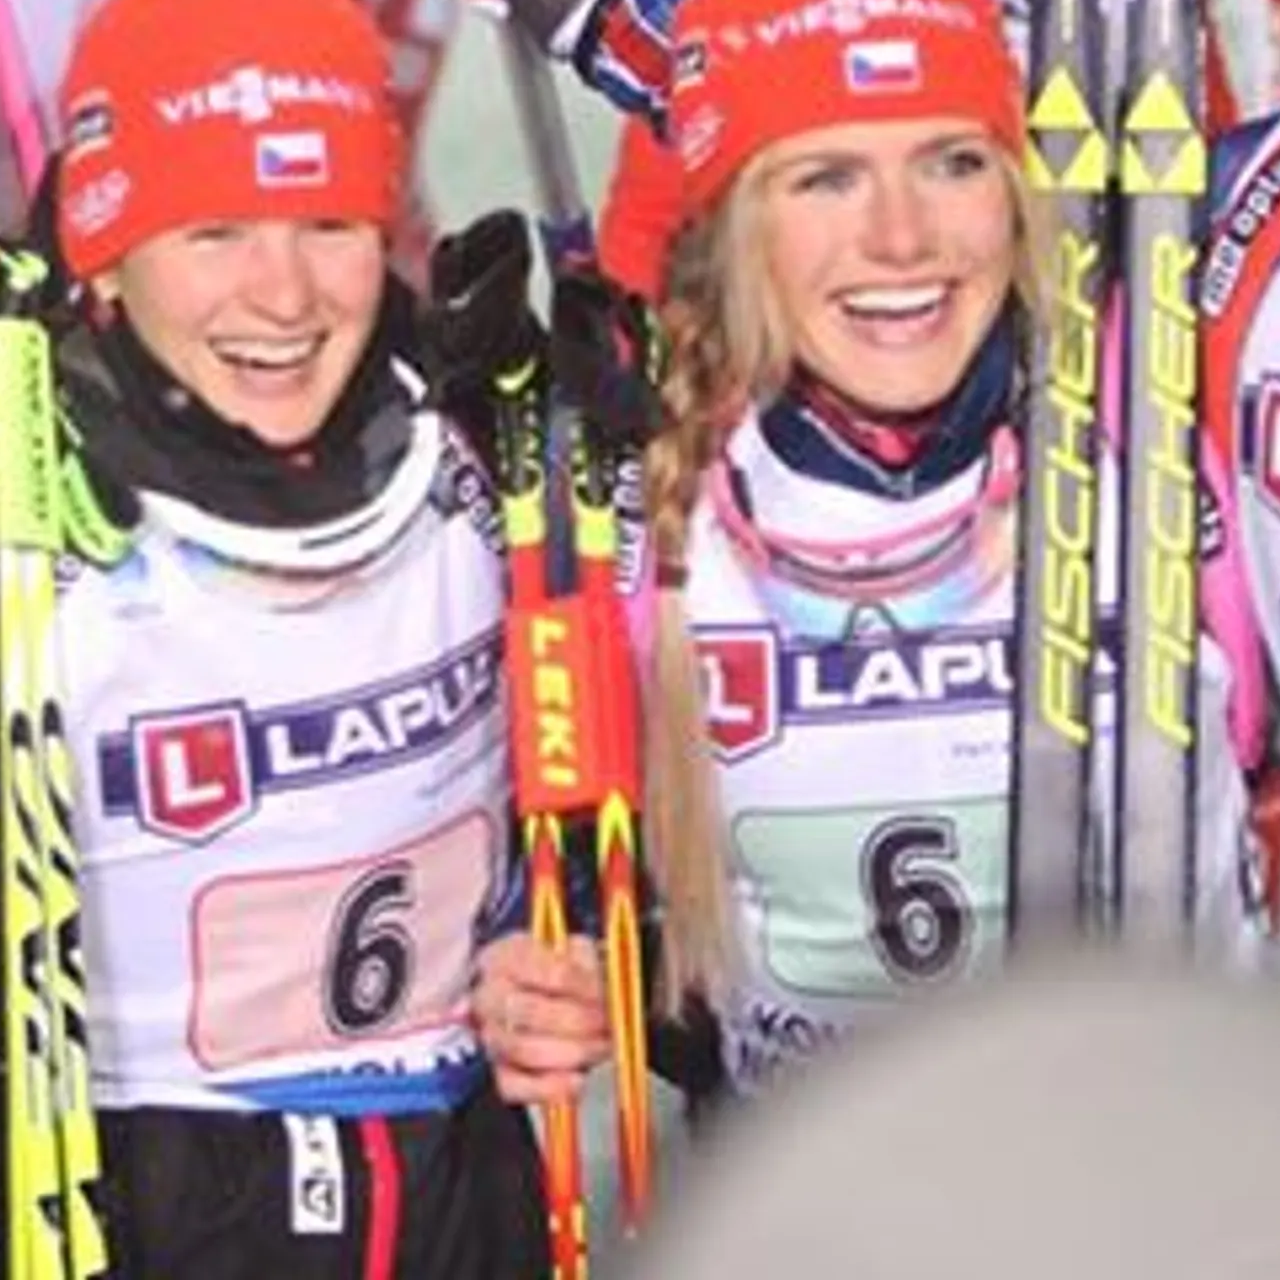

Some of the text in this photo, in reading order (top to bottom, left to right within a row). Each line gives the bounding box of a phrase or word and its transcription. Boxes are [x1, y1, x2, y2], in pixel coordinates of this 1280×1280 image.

[1042, 232, 1099, 746] FISCHER
[1147, 232, 1198, 746] FISCHER
[324, 858, 418, 1039] 6
[860, 815, 976, 988] 6
